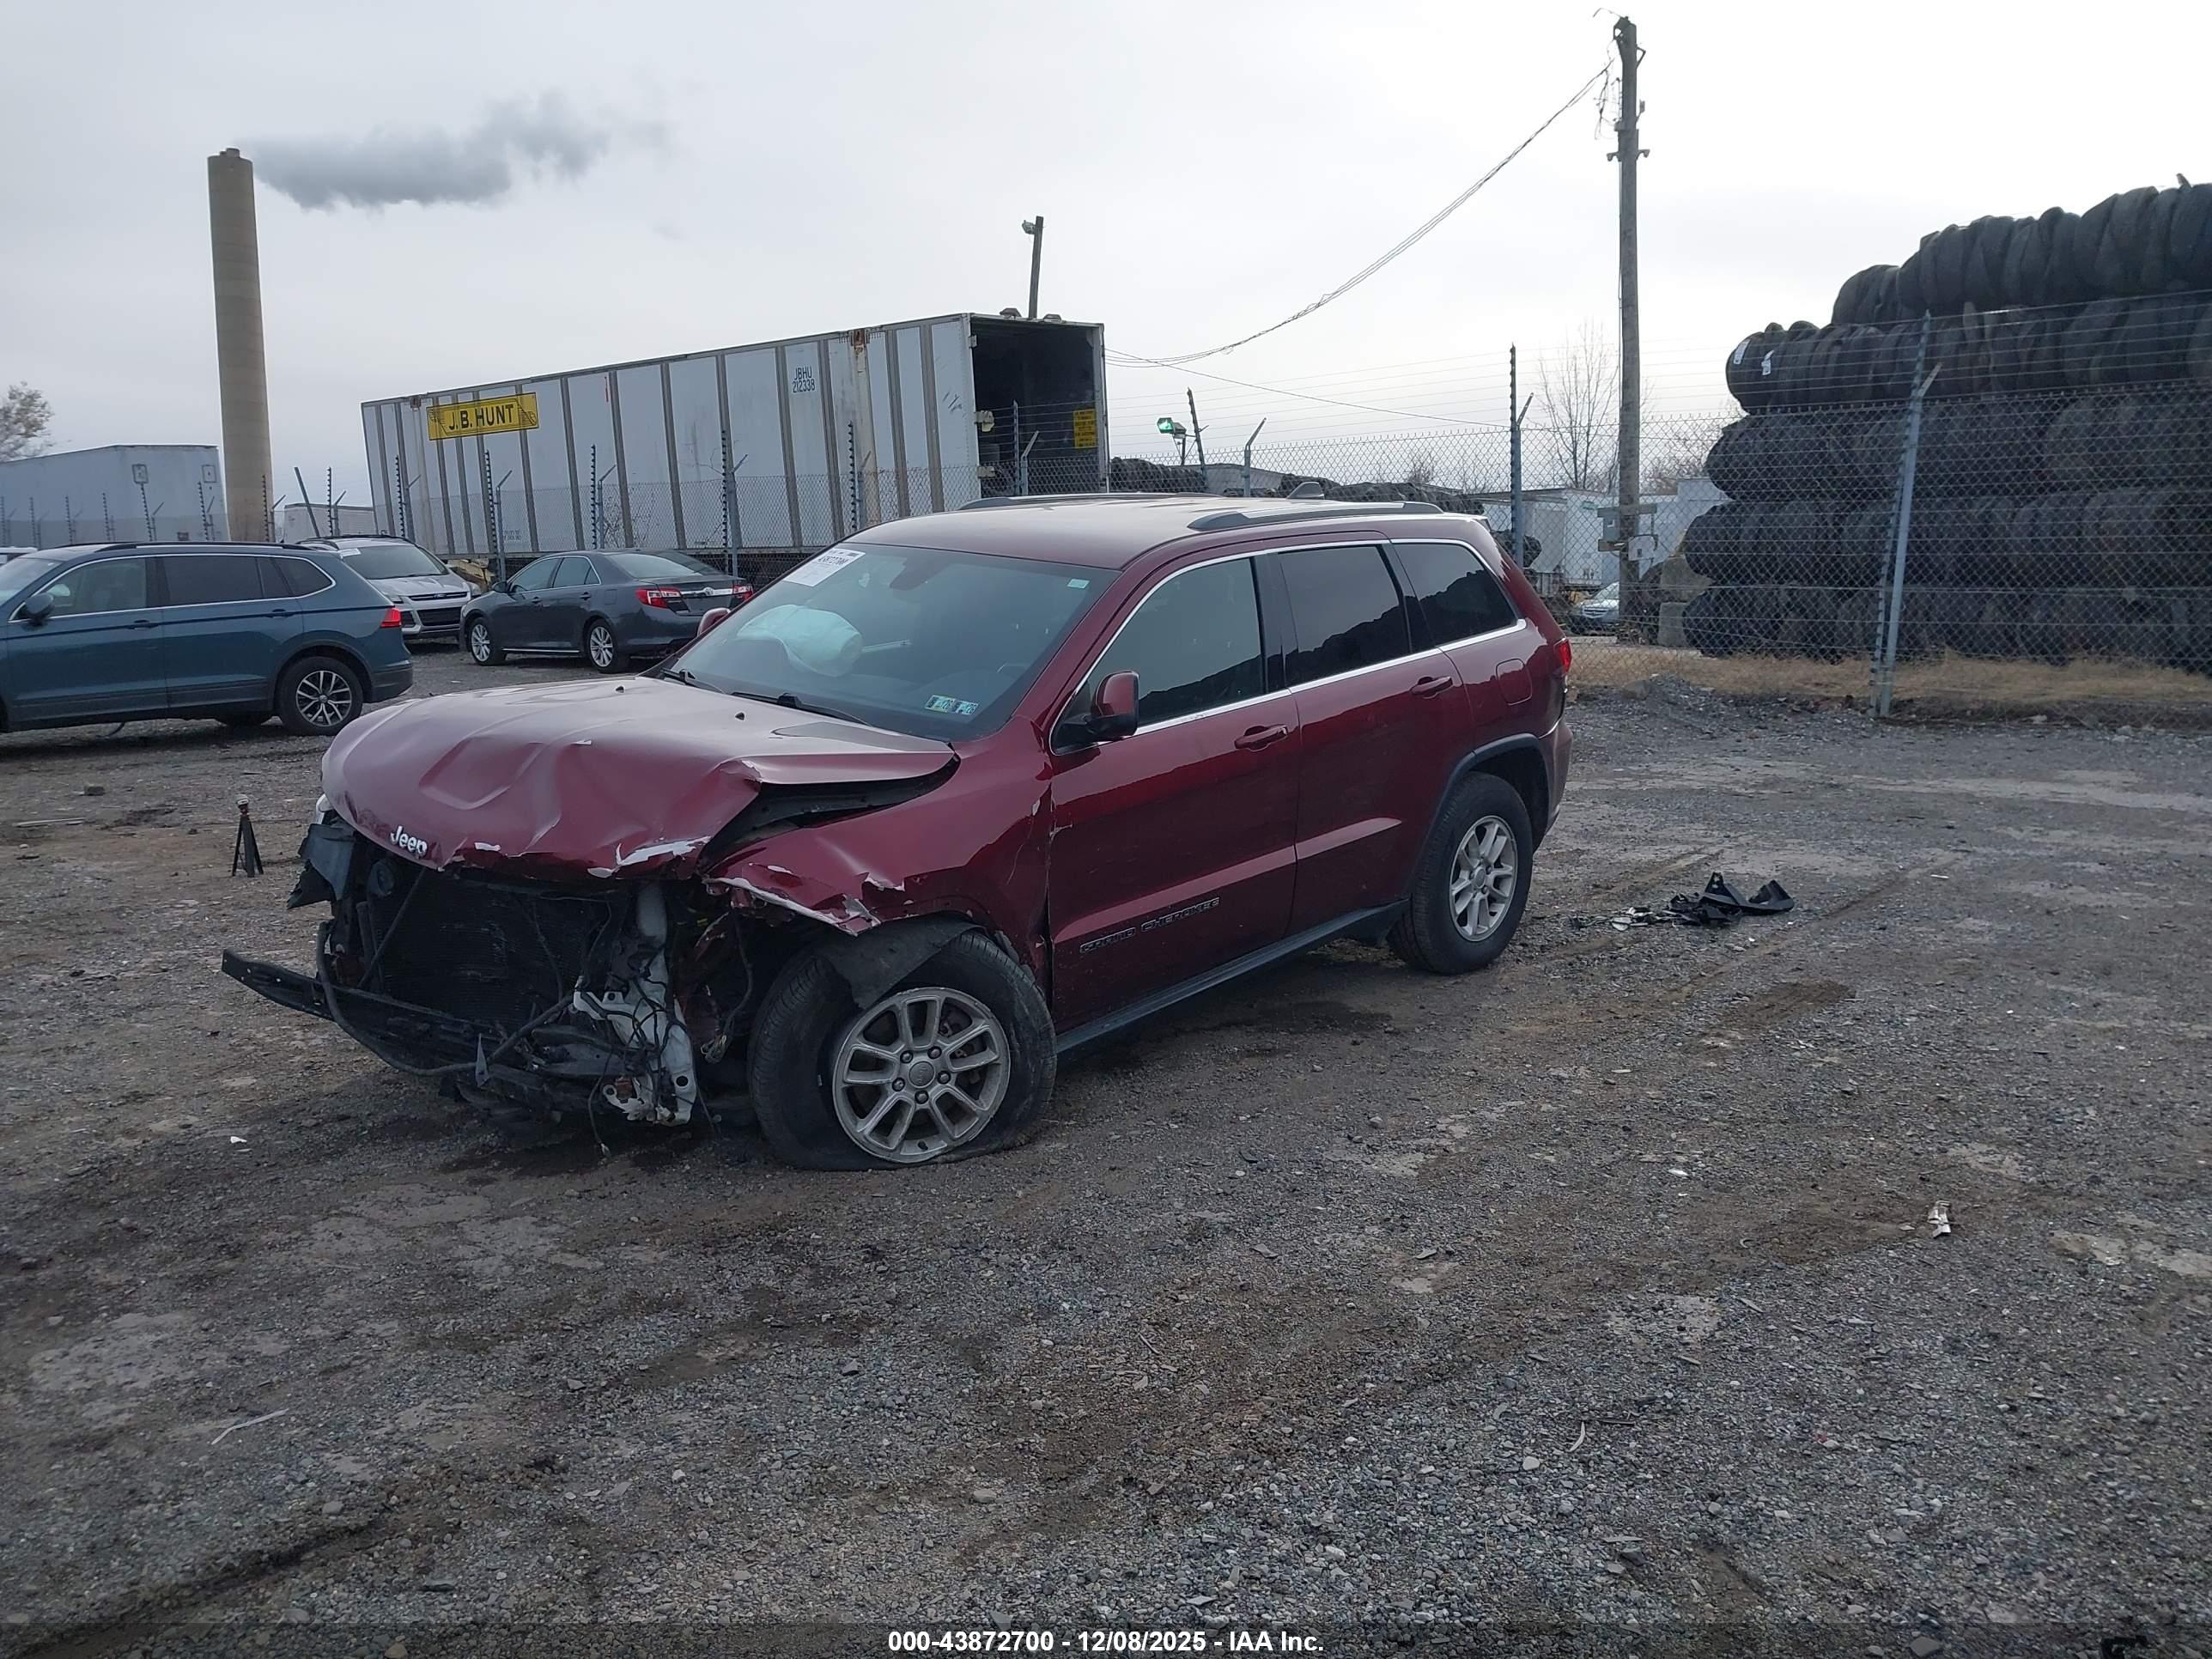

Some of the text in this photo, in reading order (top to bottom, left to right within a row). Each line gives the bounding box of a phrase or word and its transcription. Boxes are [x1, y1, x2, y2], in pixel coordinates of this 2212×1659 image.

[792, 378, 816, 393] 212338
[794, 366, 812, 380] JBHU
[390, 825, 428, 860] Jeep
[1140, 897, 1220, 932] CHEROKEE
